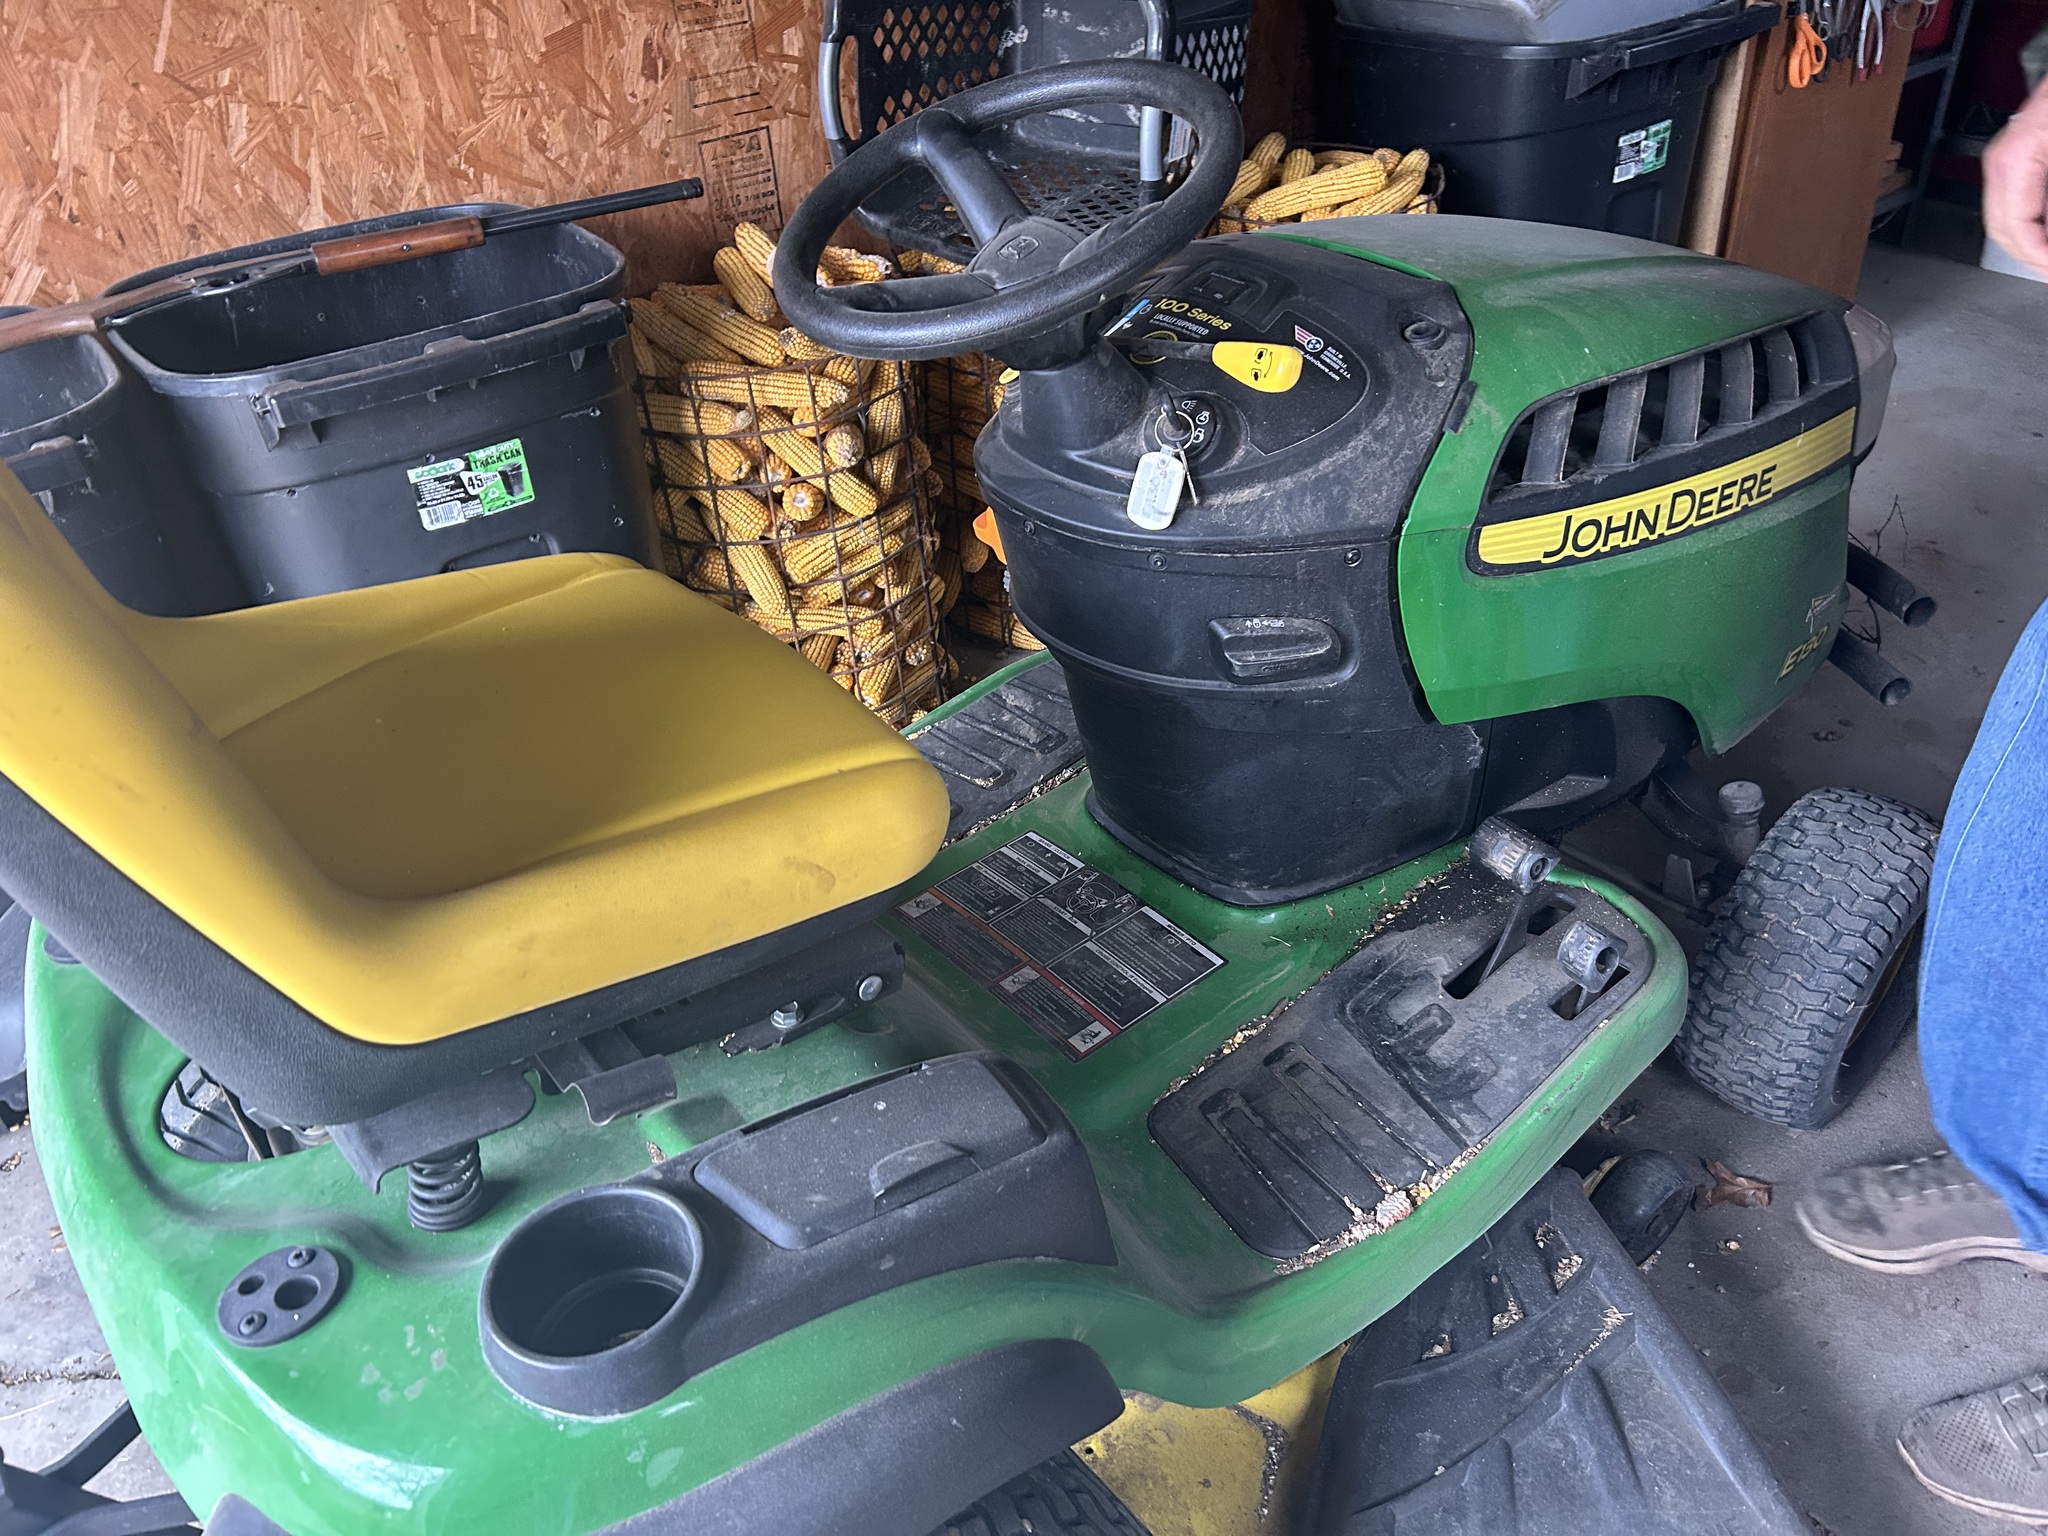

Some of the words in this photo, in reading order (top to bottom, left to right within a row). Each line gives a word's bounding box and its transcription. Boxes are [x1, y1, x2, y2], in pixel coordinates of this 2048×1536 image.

[1153, 313, 1177, 324] LOCALLY
[1175, 318, 1210, 335] SUPPORTED
[1155, 298, 1190, 313] 100
[1187, 308, 1232, 330] Series
[473, 454, 504, 469] TRASH
[503, 447, 522, 460] CAN
[467, 475, 485, 490] 45
[1542, 504, 1661, 558] JOHN
[1666, 464, 1777, 530] DEERE
[1038, 838, 1052, 847] BRAKE
[1053, 848, 1070, 859] CLUTCH
[1052, 906, 1067, 916] START
[1067, 916, 1078, 924] RUN
[1166, 923, 1184, 937] MOWER
[1185, 937, 1197, 945] PTO
[1061, 988, 1086, 1005] DANGER
